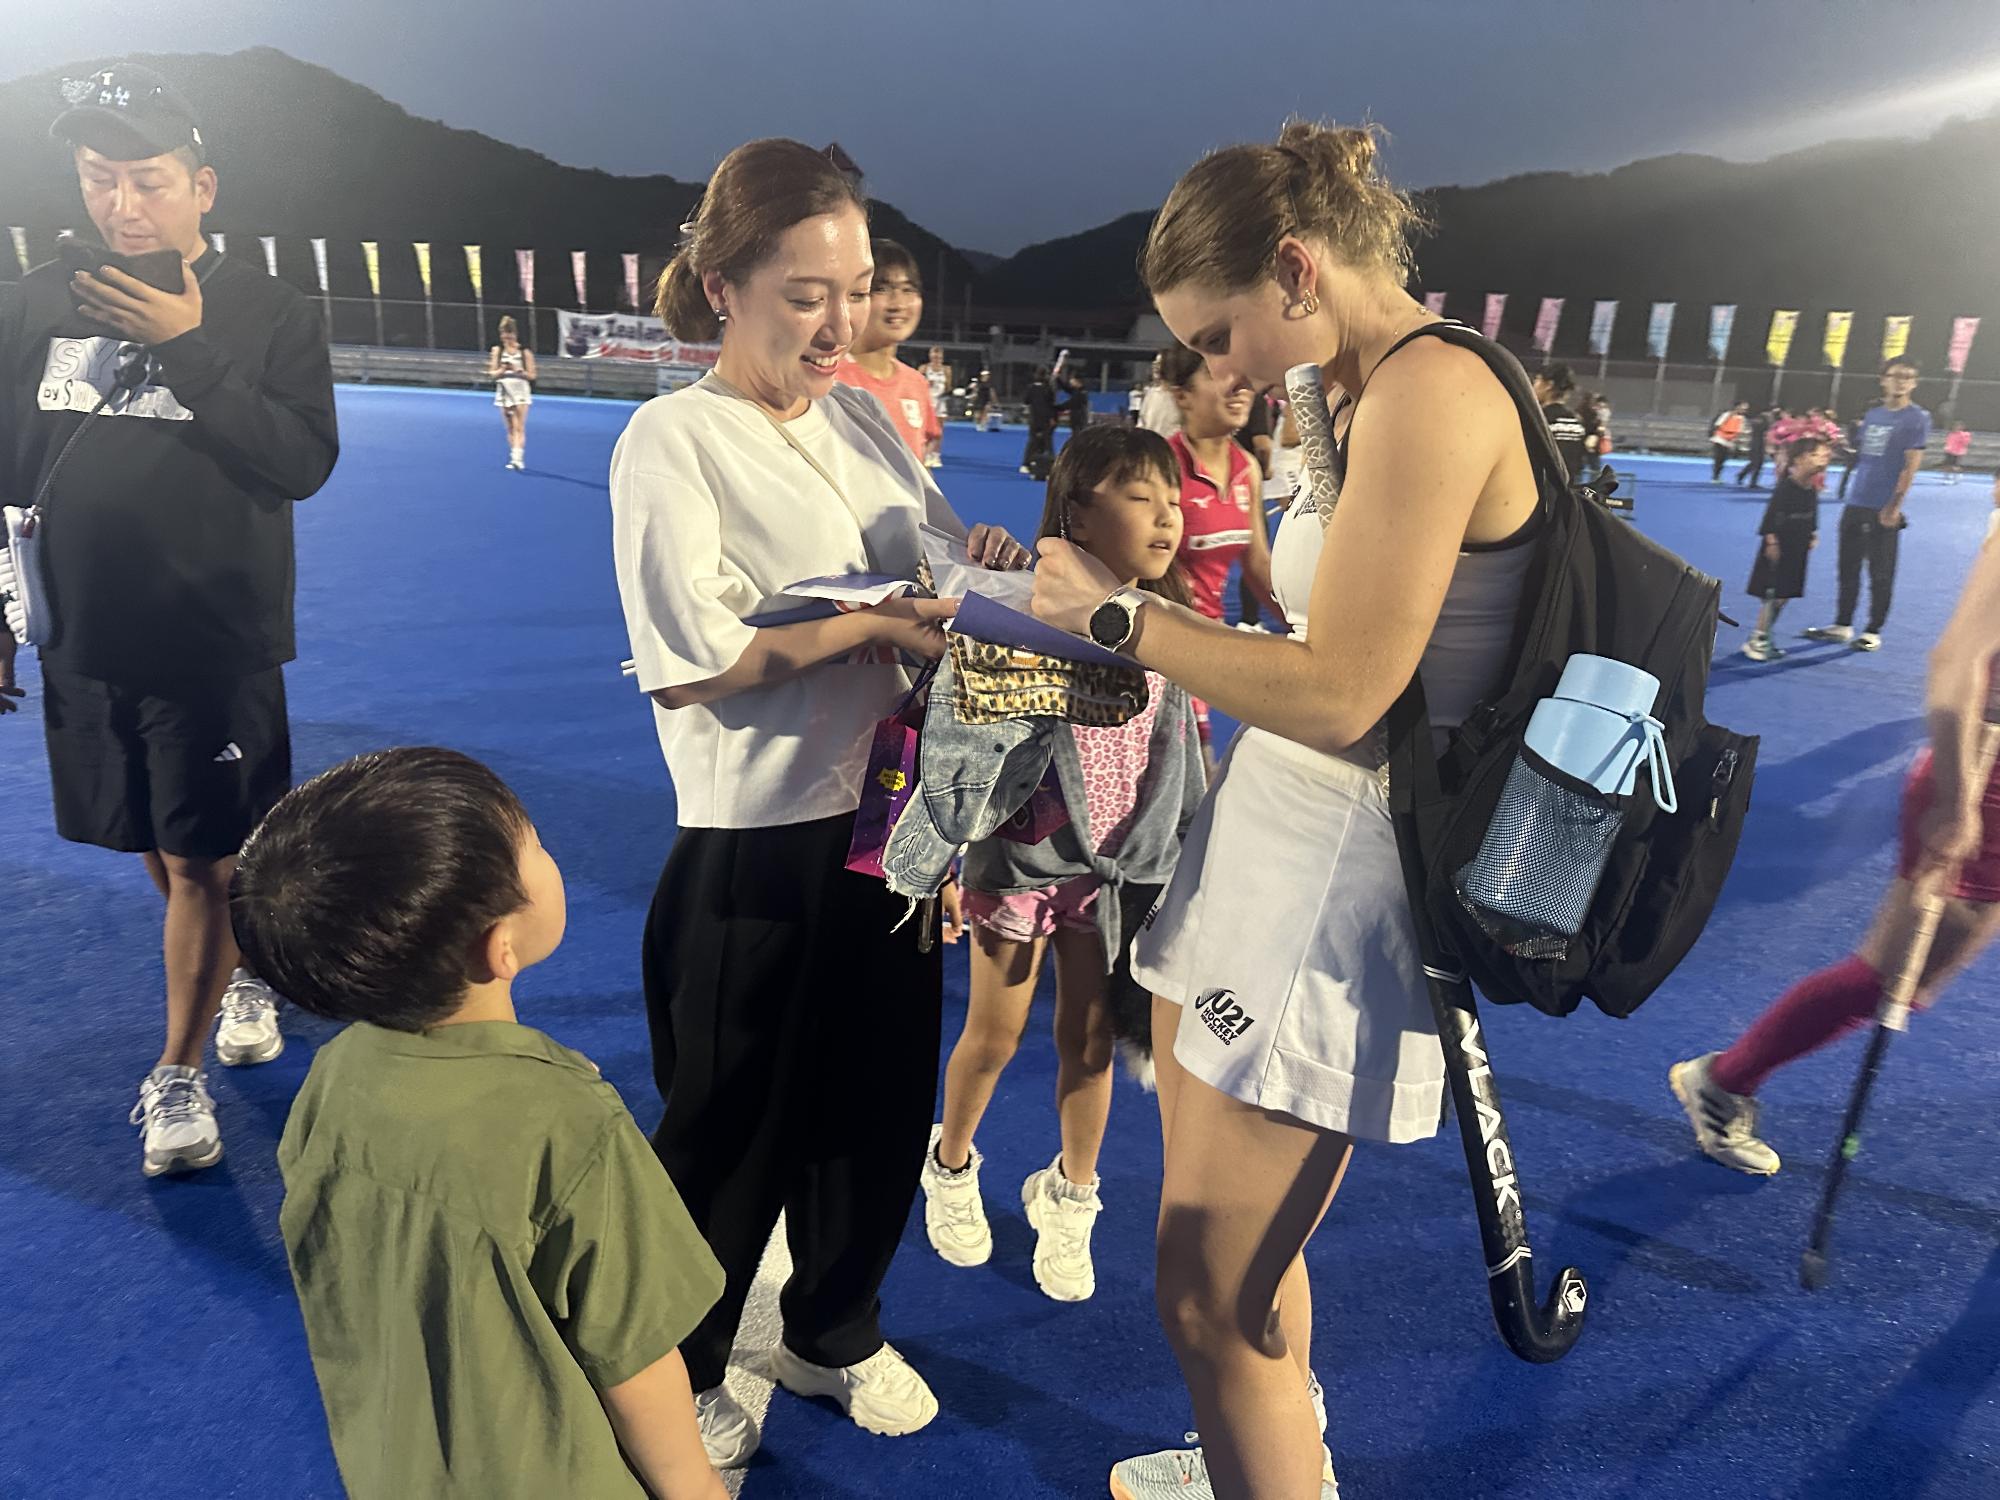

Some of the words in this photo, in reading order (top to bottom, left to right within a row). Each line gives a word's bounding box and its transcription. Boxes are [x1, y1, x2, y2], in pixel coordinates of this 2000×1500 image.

[44, 387, 58, 401] by
[1203, 1006, 1238, 1041] HOCKEY
[1211, 990, 1255, 1036] U21
[1207, 1022, 1231, 1046] ZEALAND
[1460, 1018, 1520, 1215] VLACK
